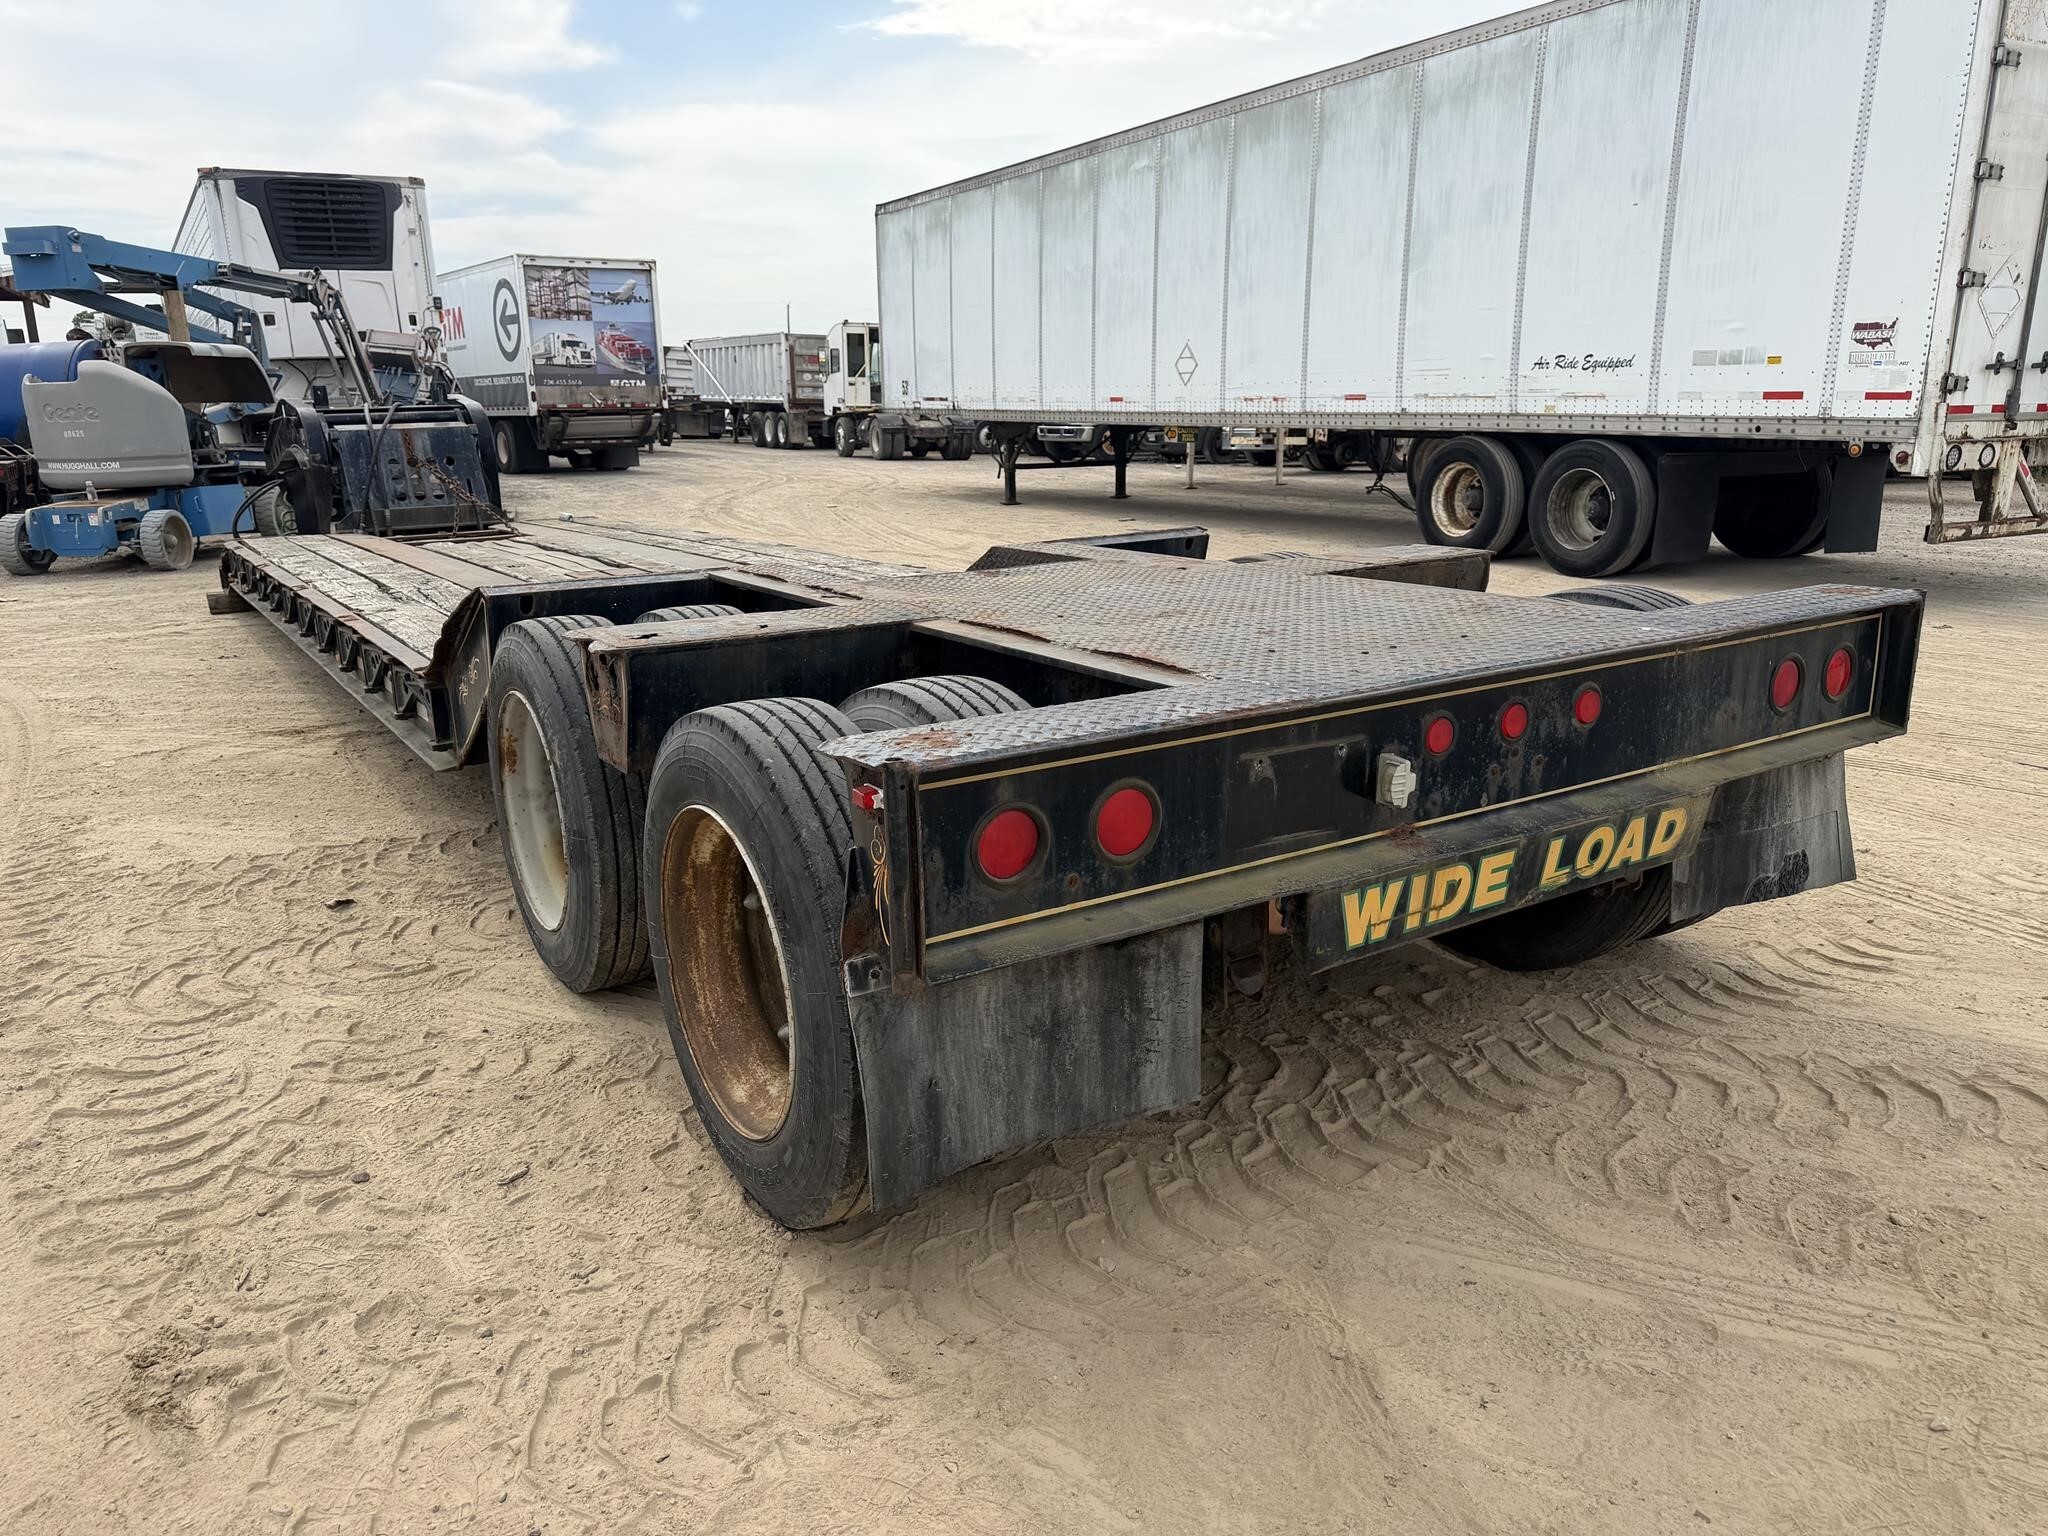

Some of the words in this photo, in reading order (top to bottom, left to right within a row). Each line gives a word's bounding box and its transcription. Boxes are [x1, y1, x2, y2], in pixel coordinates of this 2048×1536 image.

[1851, 330, 1896, 340] WABASH
[1531, 355, 1550, 371] Air
[1553, 354, 1580, 370] Ride
[1581, 353, 1636, 373] Equipped
[42, 402, 102, 423] Genie
[1342, 848, 1517, 951] WIDE
[1539, 807, 1688, 887] LOAD
